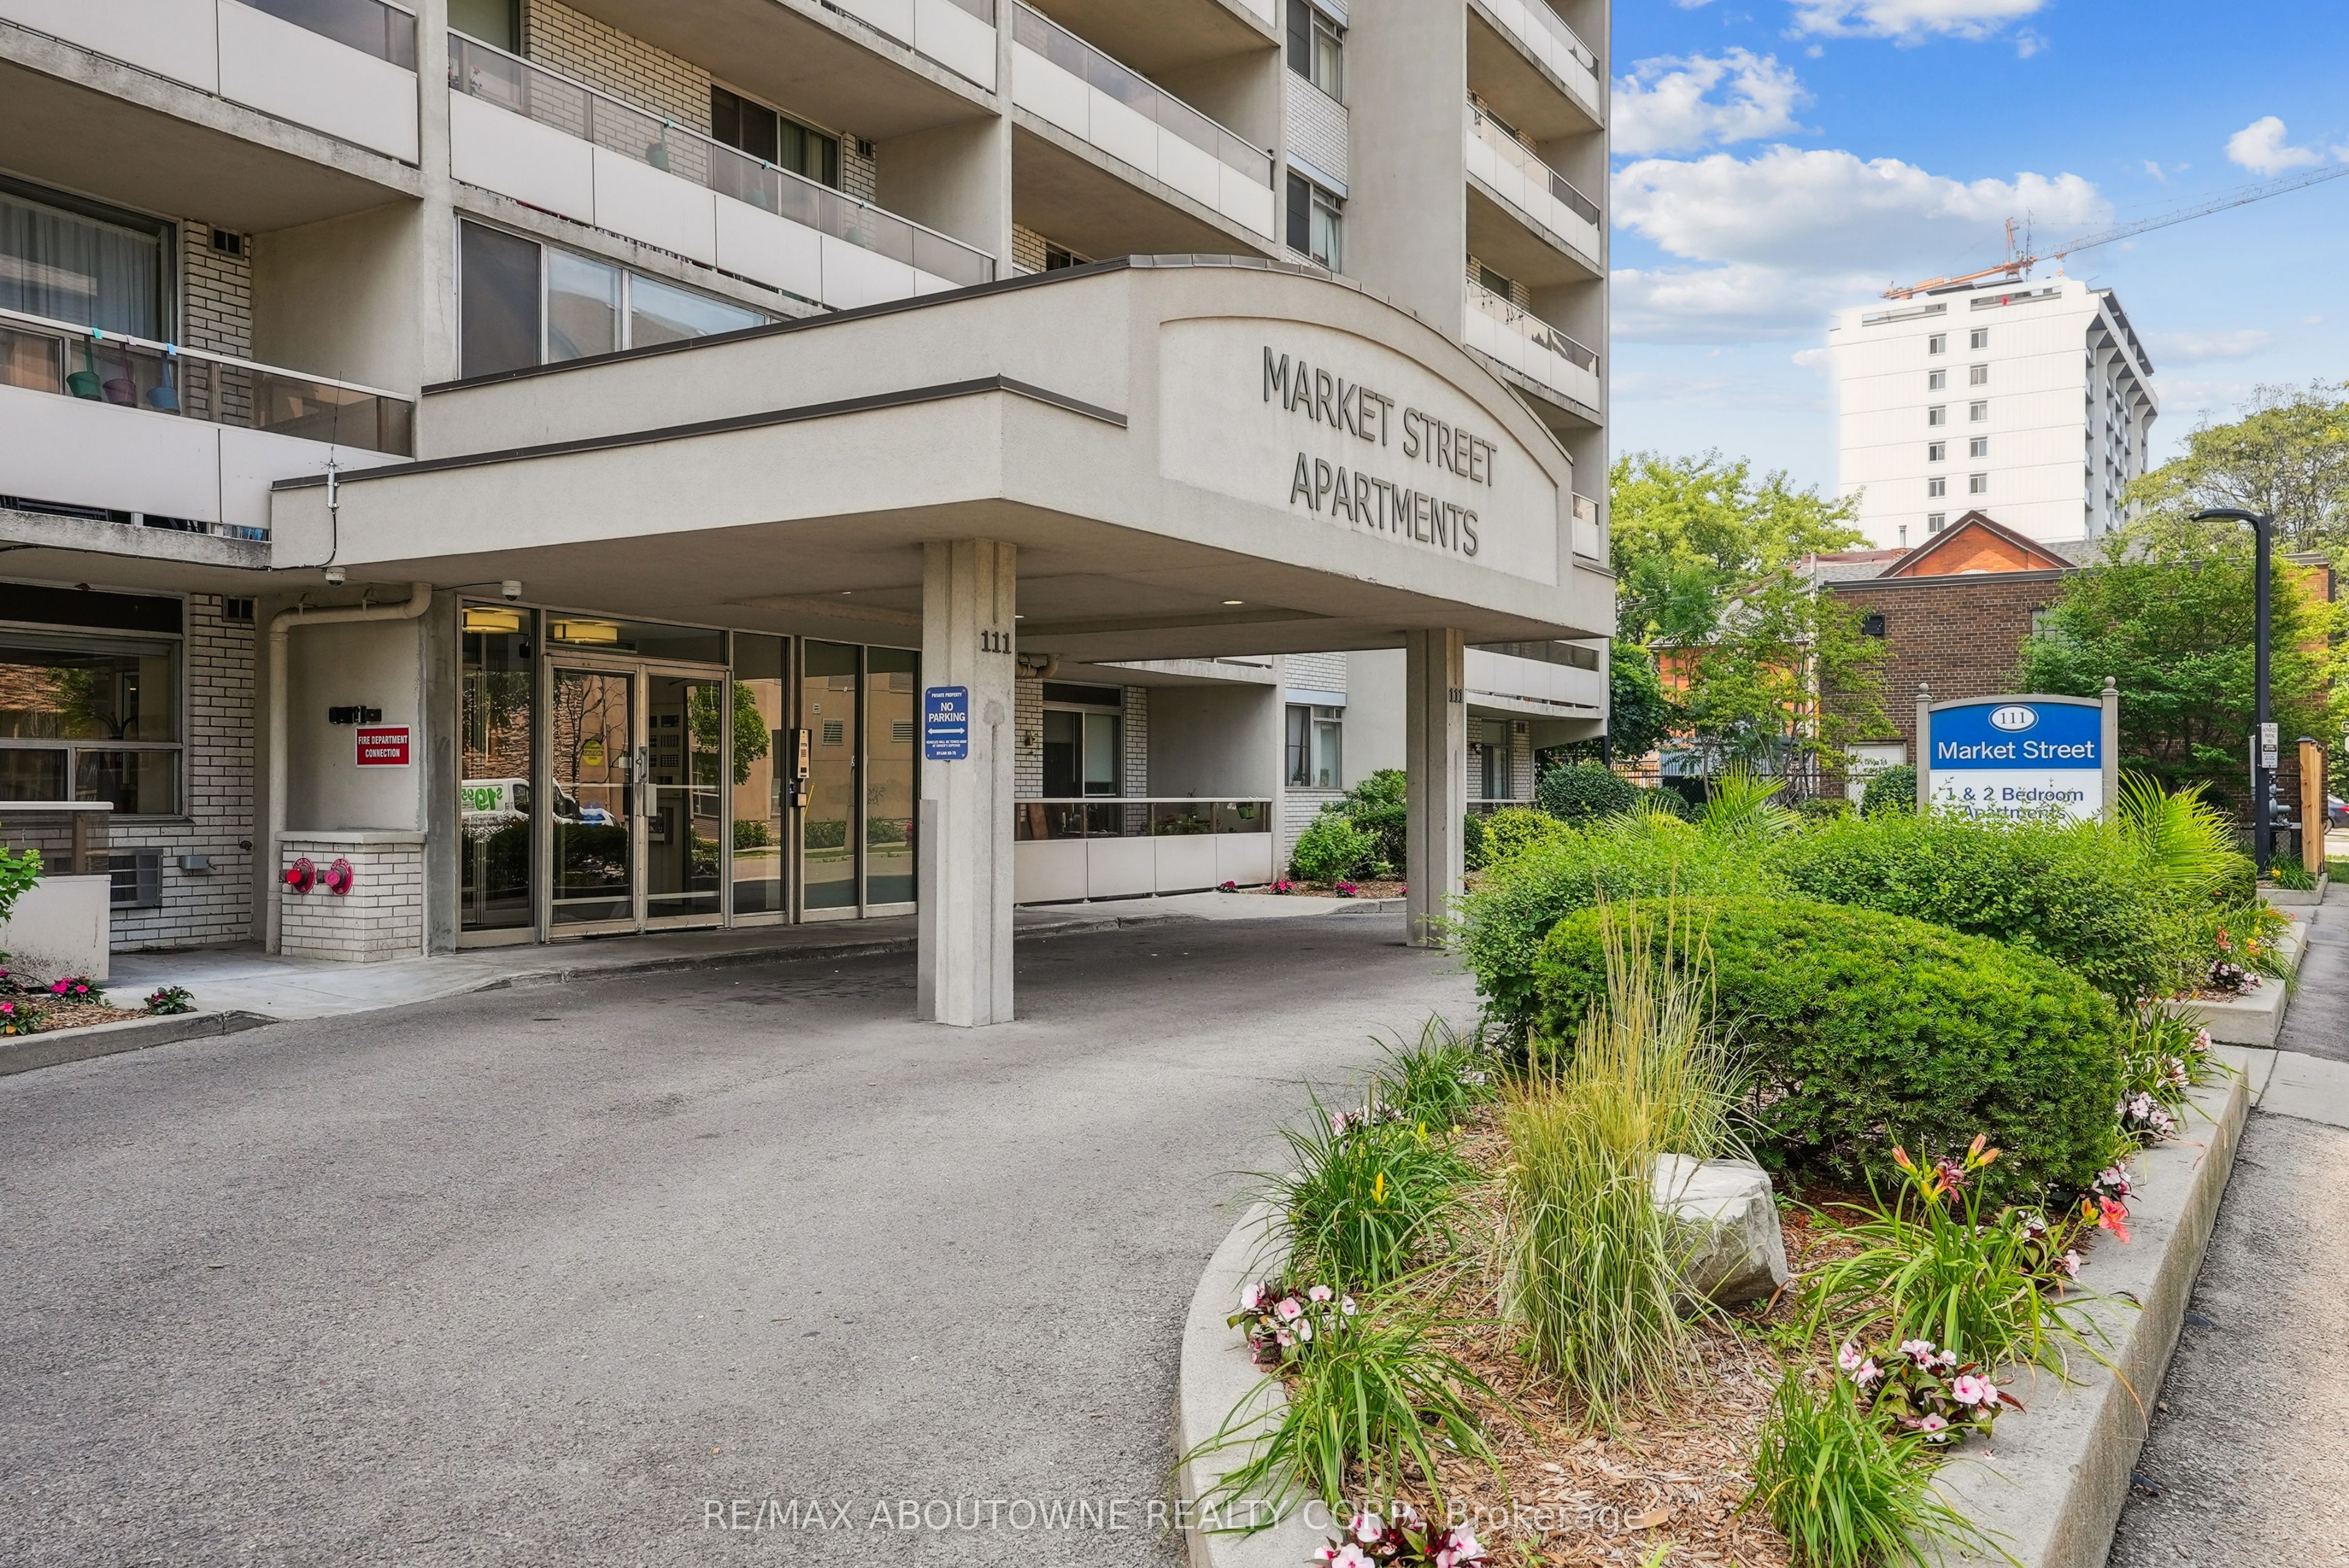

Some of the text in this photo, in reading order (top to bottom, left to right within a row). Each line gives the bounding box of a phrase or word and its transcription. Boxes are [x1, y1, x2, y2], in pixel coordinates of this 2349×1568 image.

[1264, 346, 1497, 487] MARKET STREET
[1290, 452, 1479, 556] APARTMENTS
[982, 631, 1011, 654] 111
[1449, 688, 1463, 703] 111
[940, 702, 954, 711] NO
[929, 712, 965, 722] PARKING
[2000, 711, 2025, 724] 111
[358, 735, 408, 744] FIRE DEPARTMENT
[365, 748, 400, 758] CONNECTION
[1938, 740, 2095, 760] Market Street
[1963, 787, 1976, 801] &
[1983, 786, 1994, 801] 2
[2002, 787, 2084, 801] Bedroom
